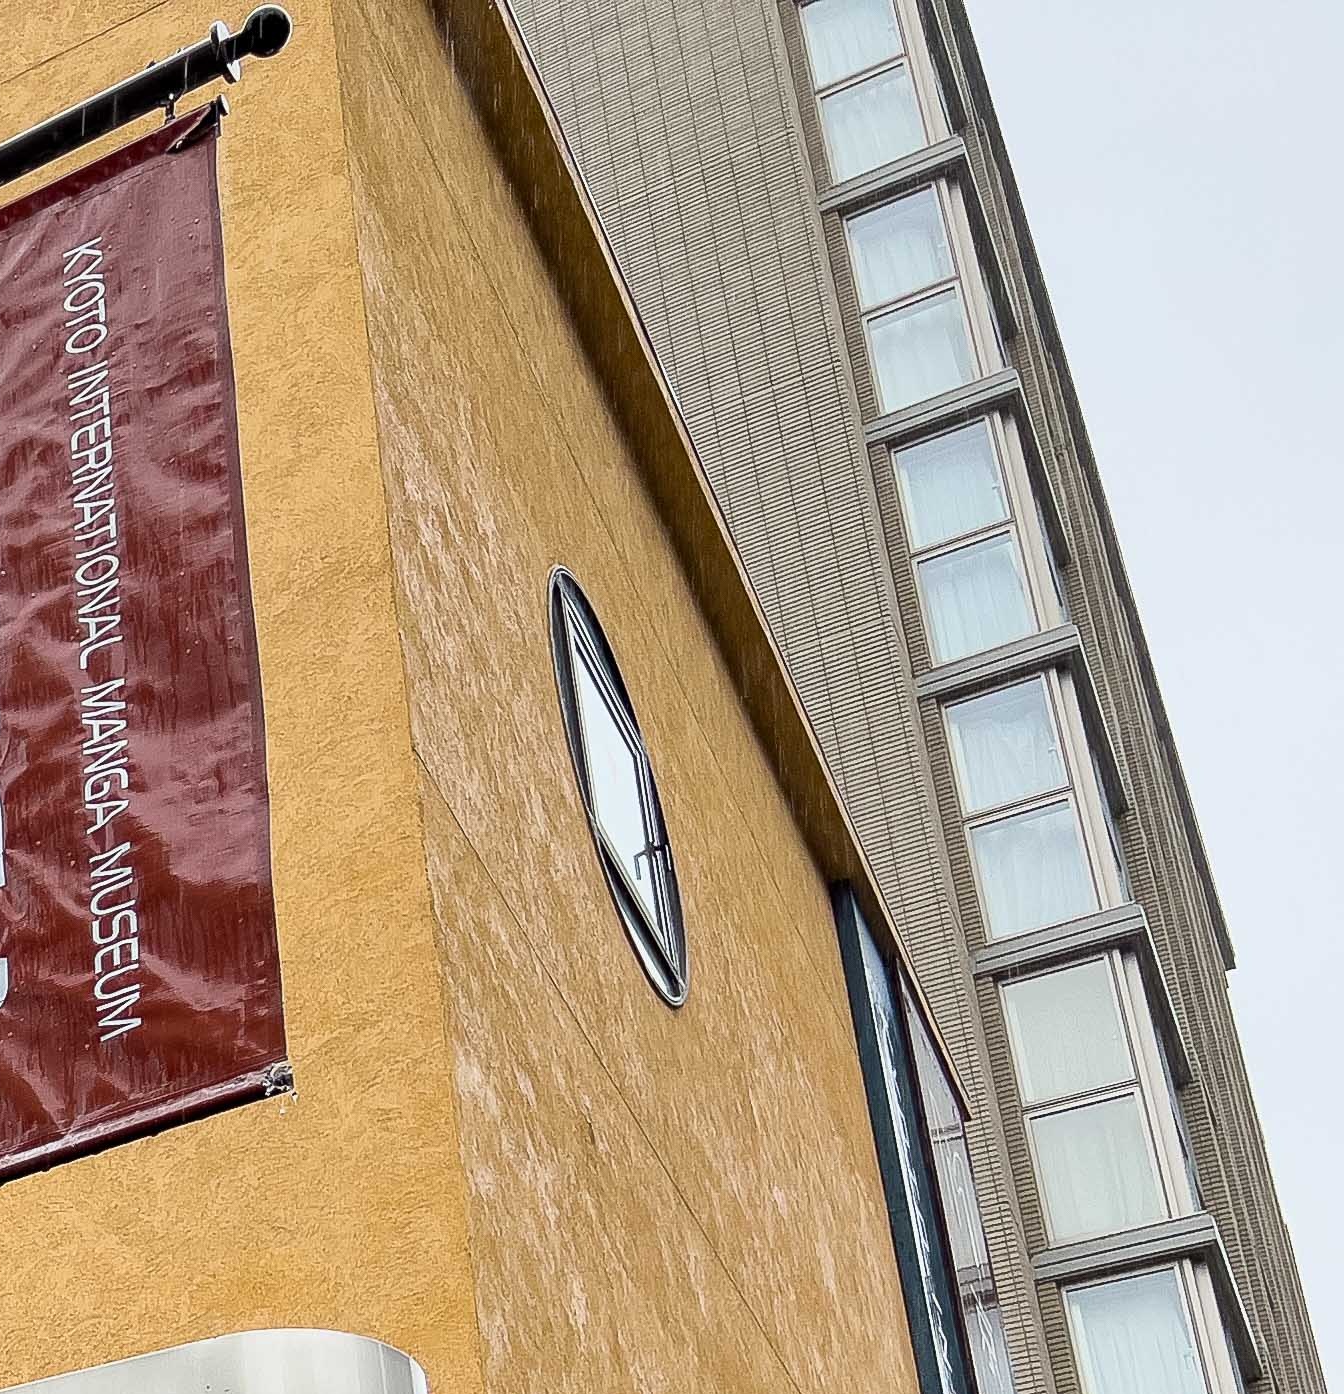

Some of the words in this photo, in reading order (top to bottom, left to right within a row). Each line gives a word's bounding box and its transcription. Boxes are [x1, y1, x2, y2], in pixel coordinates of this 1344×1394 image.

[63, 237, 108, 354] KYOTO
[68, 360, 124, 670] INTERNATIONAL
[80, 678, 130, 835] MANGA
[89, 841, 143, 1043] MUSEUM
